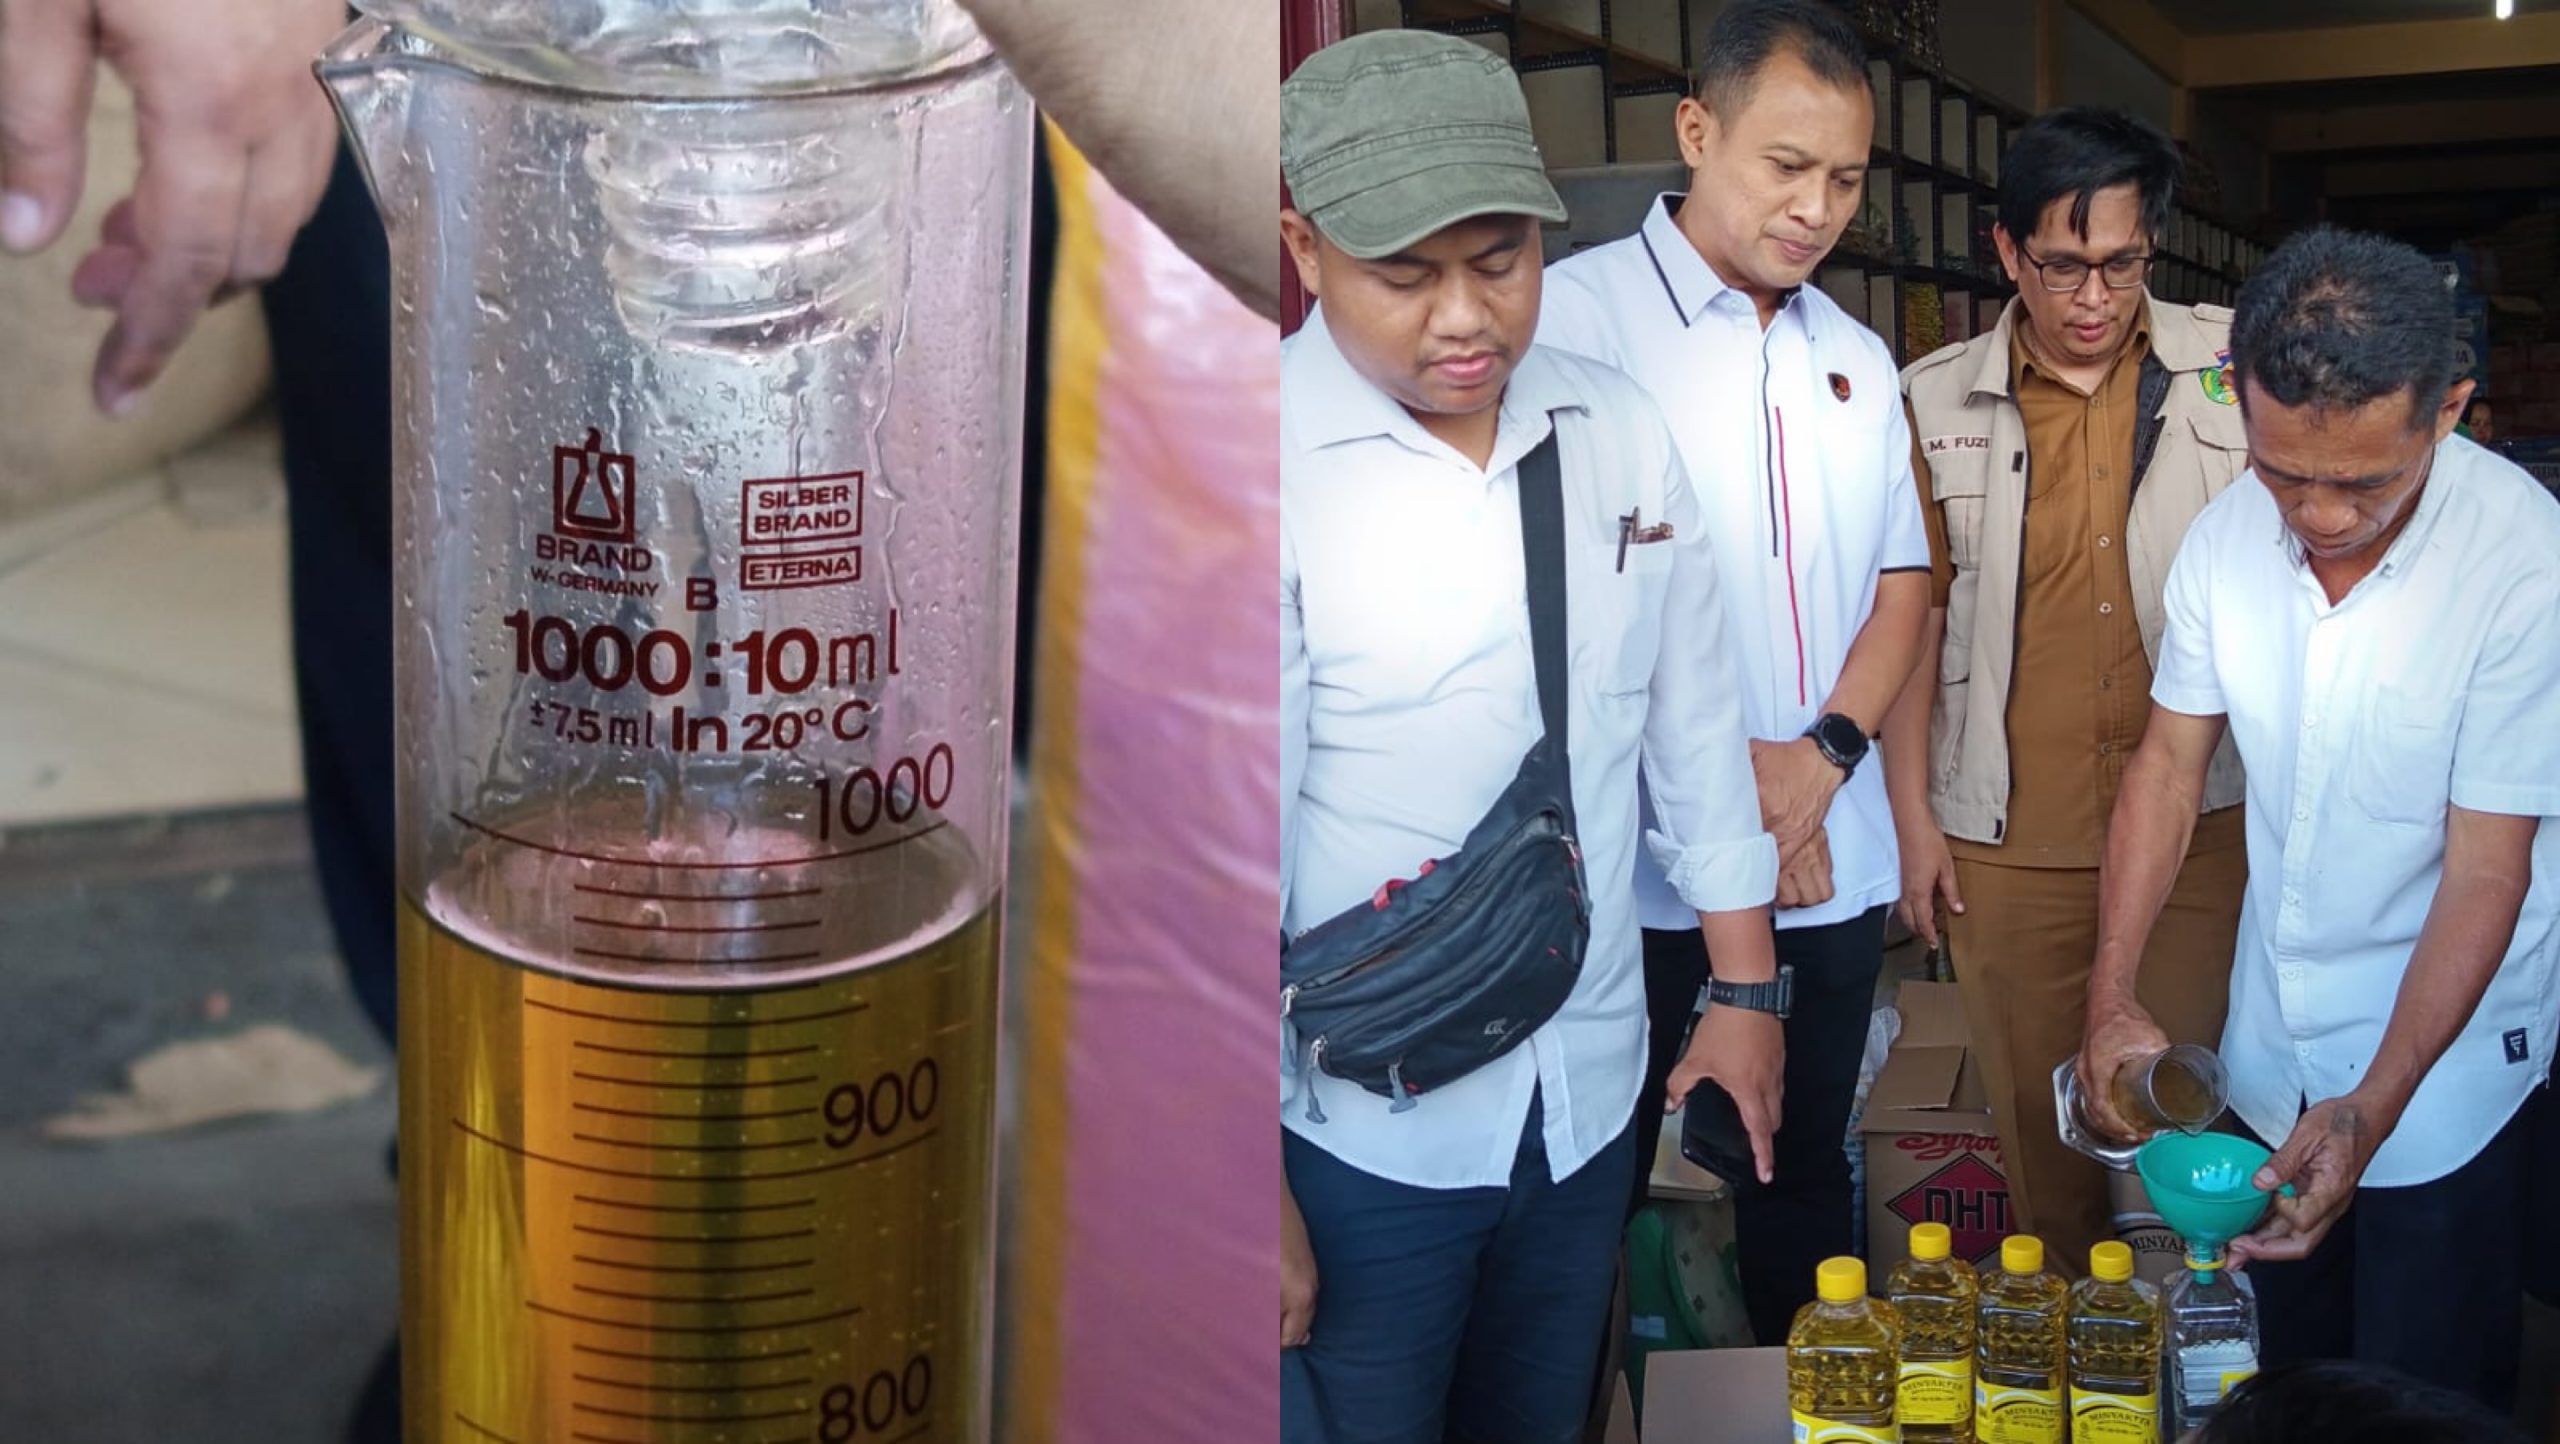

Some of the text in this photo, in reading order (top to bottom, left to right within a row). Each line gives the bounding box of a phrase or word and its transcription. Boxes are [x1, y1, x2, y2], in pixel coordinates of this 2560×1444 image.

[1929, 438, 1946, 452] M.
[758, 485, 849, 509] SILBER
[754, 509, 851, 533] BRAND
[536, 534, 653, 573] BRAND
[749, 556, 852, 582] ETERNA
[531, 566, 659, 599] W-GERMANY
[686, 577, 718, 612] B
[814, 742, 954, 842] 1000
[823, 1056, 939, 1149] 900
[1924, 1187, 2009, 1231] DHT
[818, 1354, 933, 1444] 800
